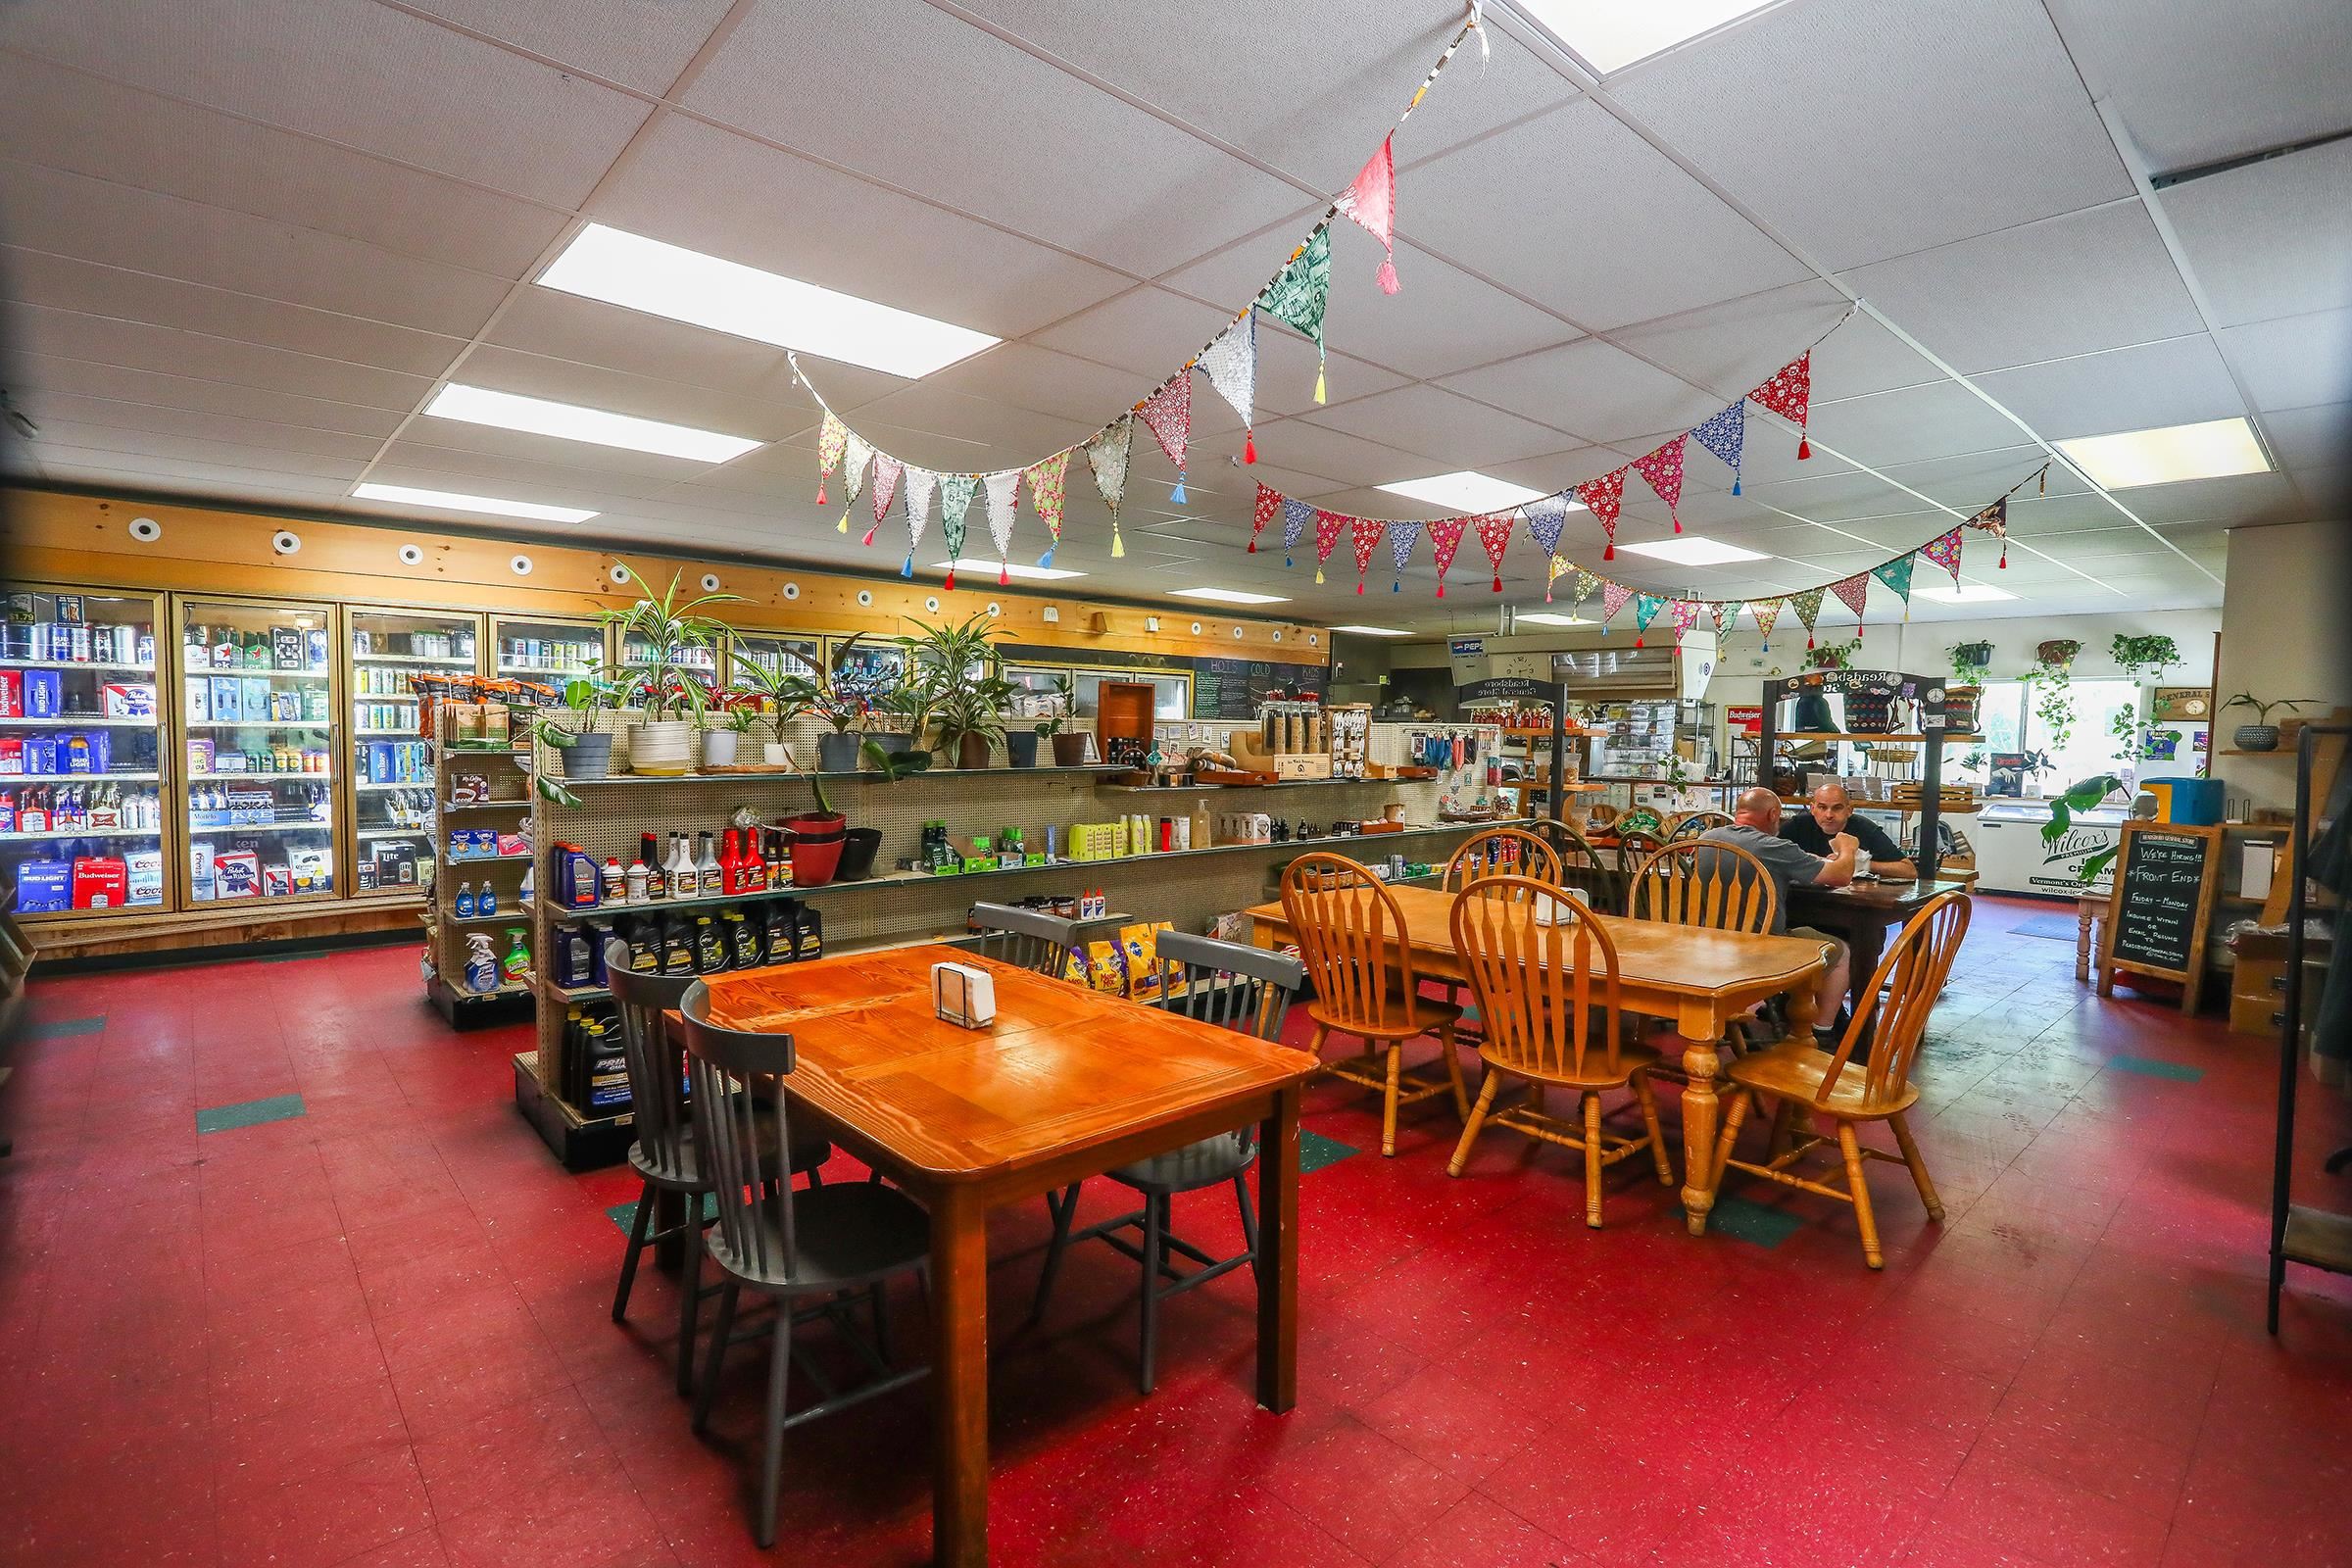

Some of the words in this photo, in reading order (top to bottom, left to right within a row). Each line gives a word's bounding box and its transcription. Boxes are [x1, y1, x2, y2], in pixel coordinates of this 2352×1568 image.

[1464, 642, 1484, 651] PEPS
[1210, 660, 1238, 671] HOTS
[1250, 663, 1271, 675] COLD
[231, 809, 273, 819] ALE
[2042, 829, 2109, 856] Wilcox's
[382, 853, 399, 862] Lite
[2061, 848, 2093, 858] PREMIUM
[135, 860, 161, 869] Coo
[226, 865, 245, 874] Pabst
[360, 875, 370, 889] Lite
[2032, 876, 2069, 886] Vermont's
[1102, 979, 1115, 988] Mix
